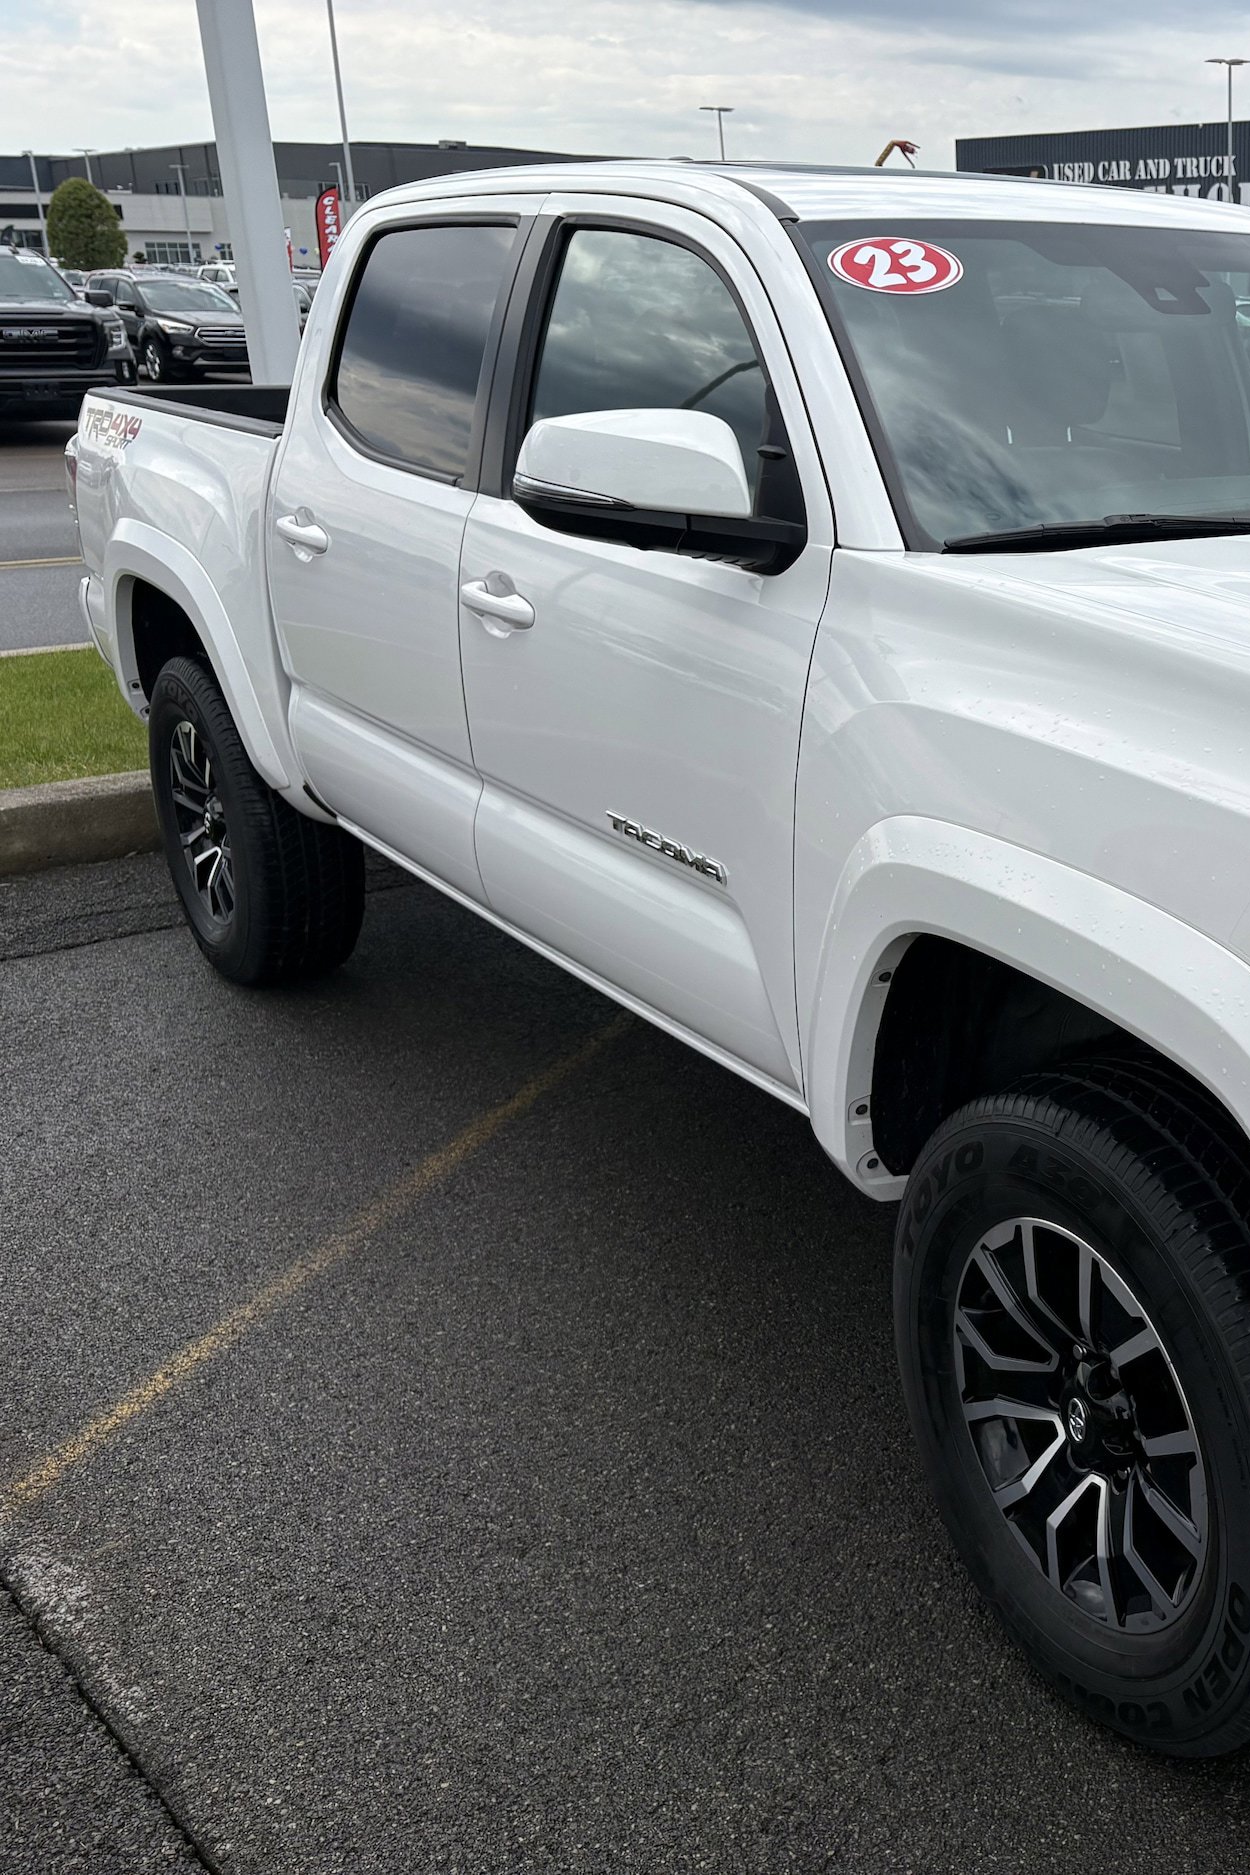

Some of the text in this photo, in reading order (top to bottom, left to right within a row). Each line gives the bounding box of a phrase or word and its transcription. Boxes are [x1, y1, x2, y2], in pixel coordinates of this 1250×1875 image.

[1053, 155, 1237, 183] USED CAR AND TRUCK
[853, 241, 937, 288] 23
[86, 407, 114, 442] TRD
[104, 434, 133, 450] SPORT
[605, 809, 728, 887] TACOMA
[901, 1140, 985, 1259] TOYO
